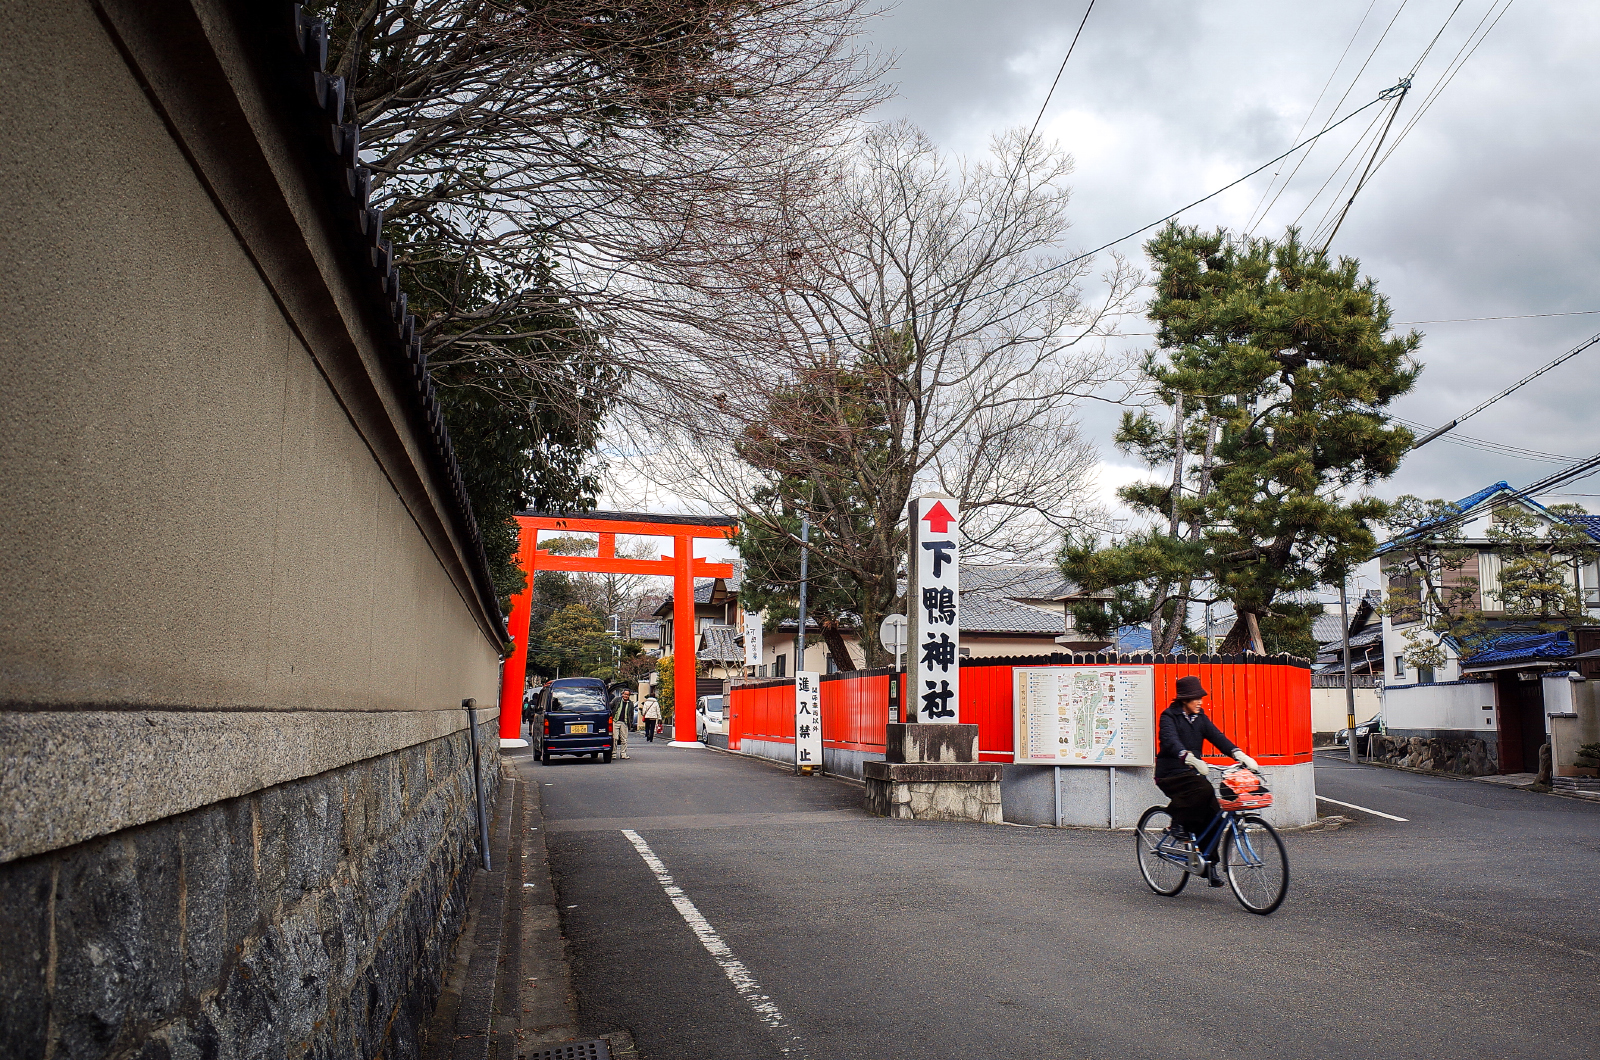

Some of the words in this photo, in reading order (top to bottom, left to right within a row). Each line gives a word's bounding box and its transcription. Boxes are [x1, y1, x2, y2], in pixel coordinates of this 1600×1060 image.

[919, 540, 957, 720] 下鴨神社
[798, 676, 812, 762] 進入禁止
